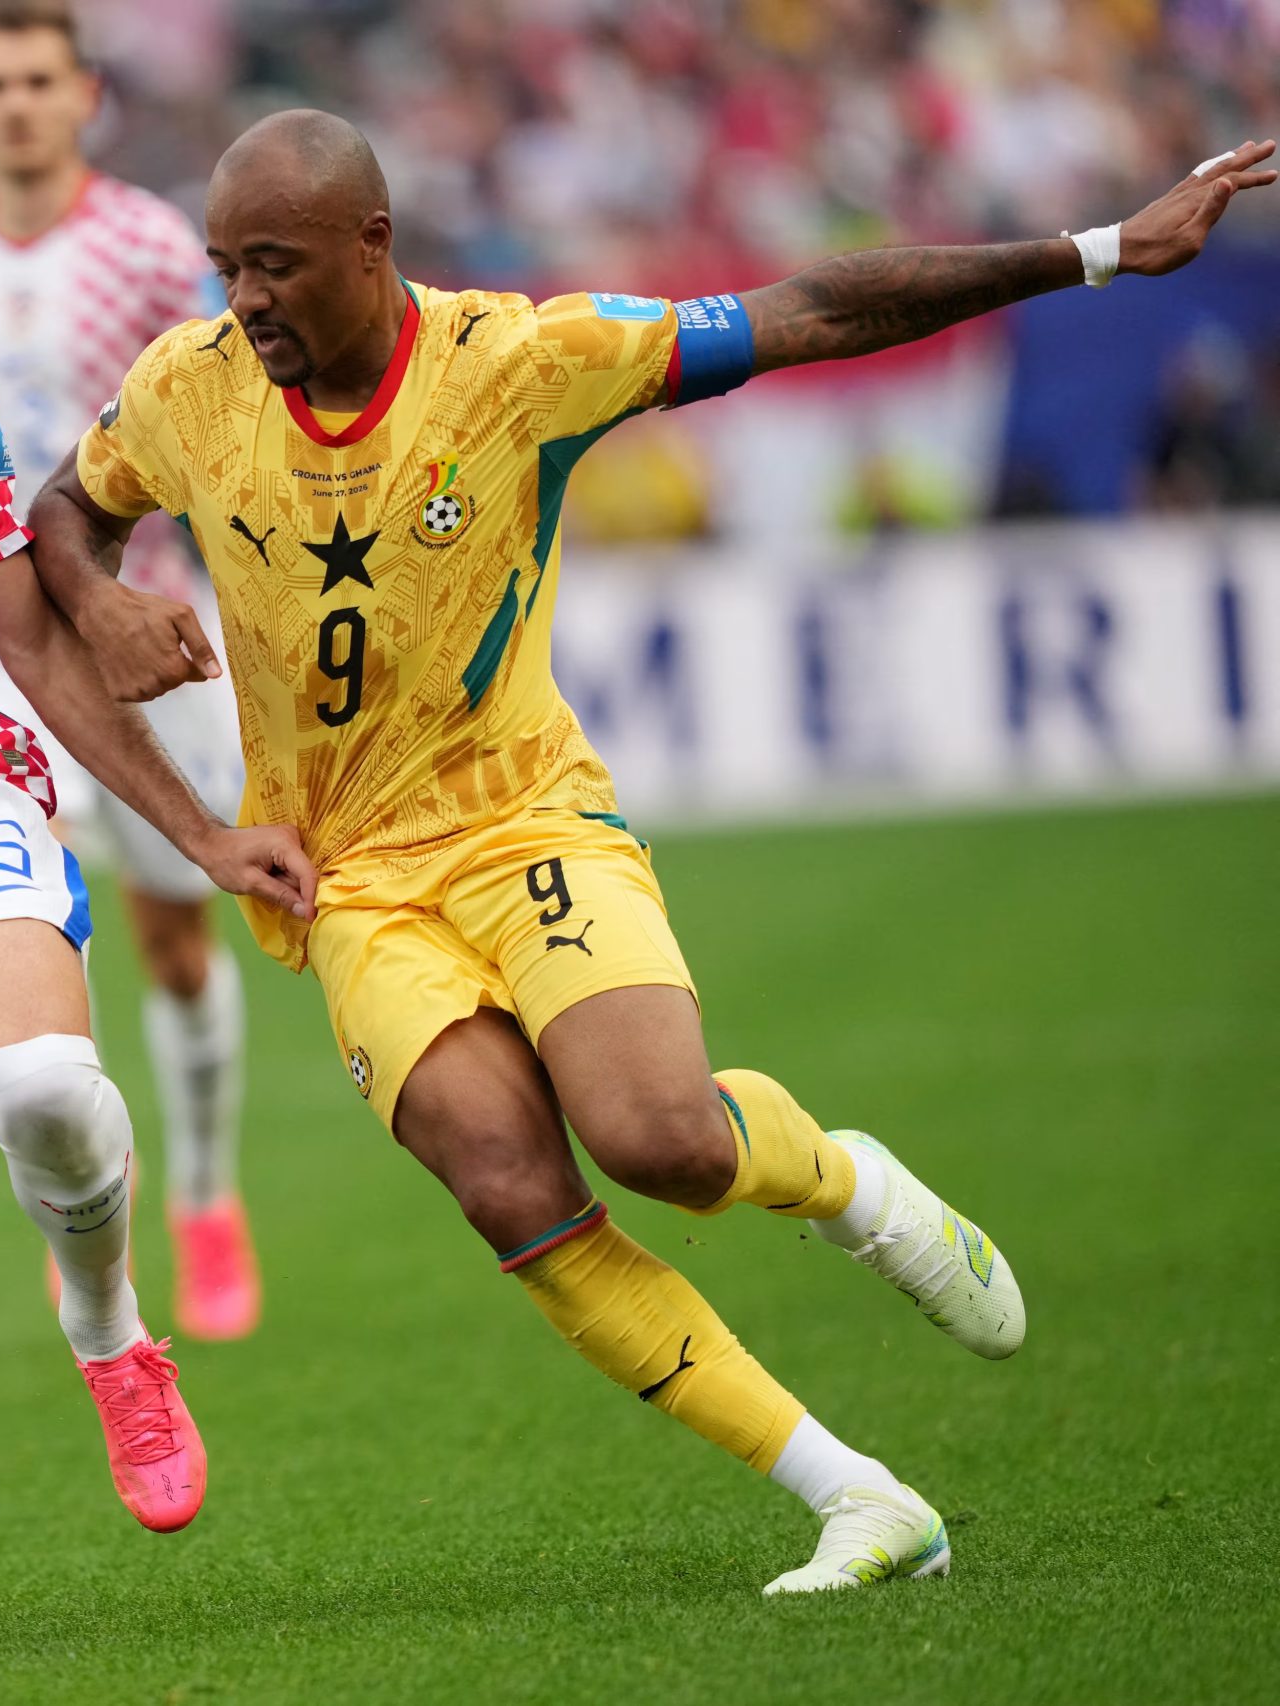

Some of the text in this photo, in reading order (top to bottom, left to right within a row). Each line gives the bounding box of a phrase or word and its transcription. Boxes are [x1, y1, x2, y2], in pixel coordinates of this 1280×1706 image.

[711, 308, 731, 332] the
[291, 462, 383, 482] CROATIA VS GHANA
[311, 489, 333, 498] June
[348, 483, 369, 496] 2026
[316, 605, 367, 728] 9
[526, 857, 573, 926] 9
[161, 1473, 177, 1504] F50
